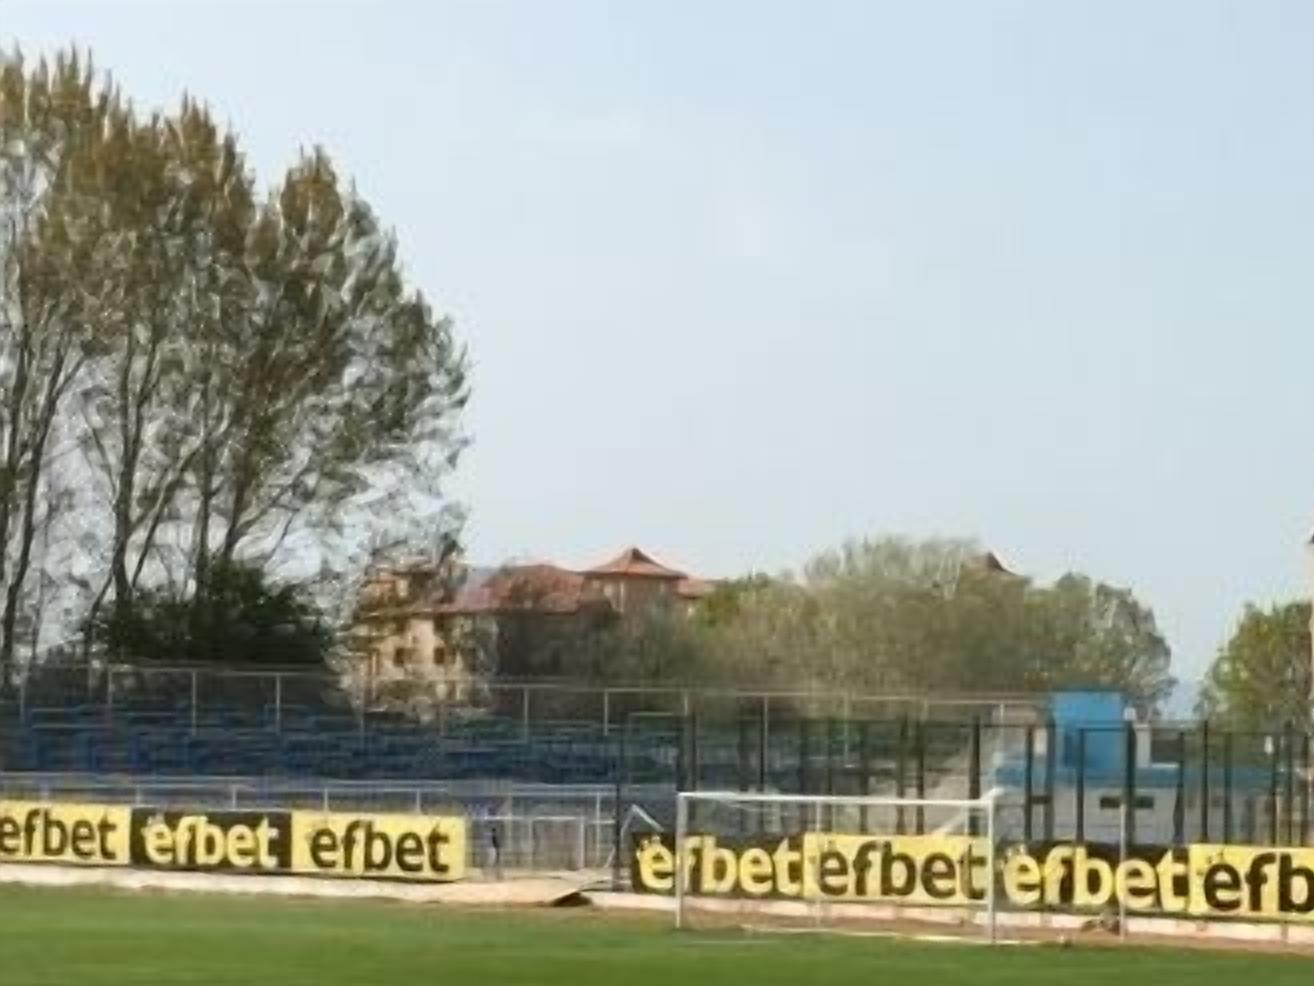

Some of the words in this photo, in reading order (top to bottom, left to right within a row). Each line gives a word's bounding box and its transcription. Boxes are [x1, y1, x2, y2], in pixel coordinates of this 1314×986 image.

[0, 807, 117, 860] efbet
[144, 812, 280, 867] efbet
[309, 812, 450, 873] efbet
[638, 835, 801, 895] efbet
[817, 840, 987, 900] efbet
[1002, 846, 1189, 910] efbet
